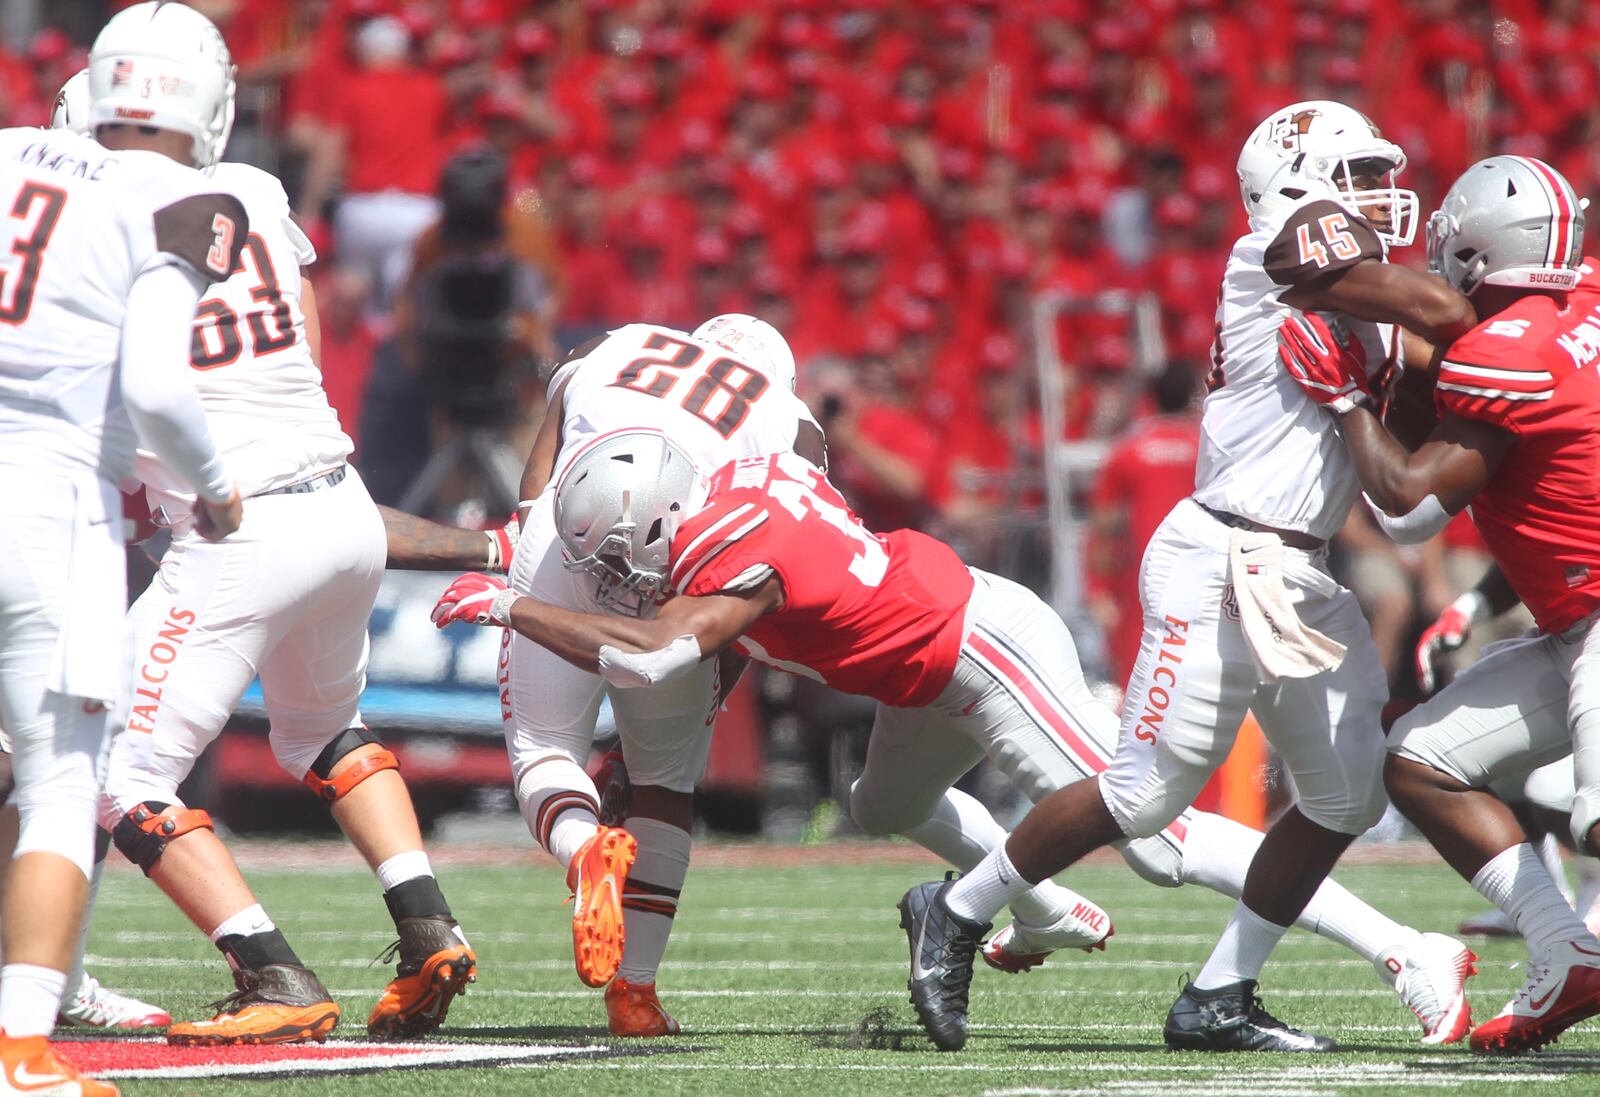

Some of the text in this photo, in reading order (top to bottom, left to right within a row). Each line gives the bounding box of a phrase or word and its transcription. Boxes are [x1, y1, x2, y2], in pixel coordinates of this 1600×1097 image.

[0, 179, 68, 327] 3
[206, 212, 236, 277] 3
[1296, 213, 1362, 269] 45
[1529, 273, 1573, 287] BUCKEYES
[604, 332, 770, 441] 28
[127, 606, 197, 735] FALCONS
[499, 626, 513, 722] FALCO
[1134, 613, 1190, 747] FALCONS
[1070, 902, 1107, 932] NIKE
